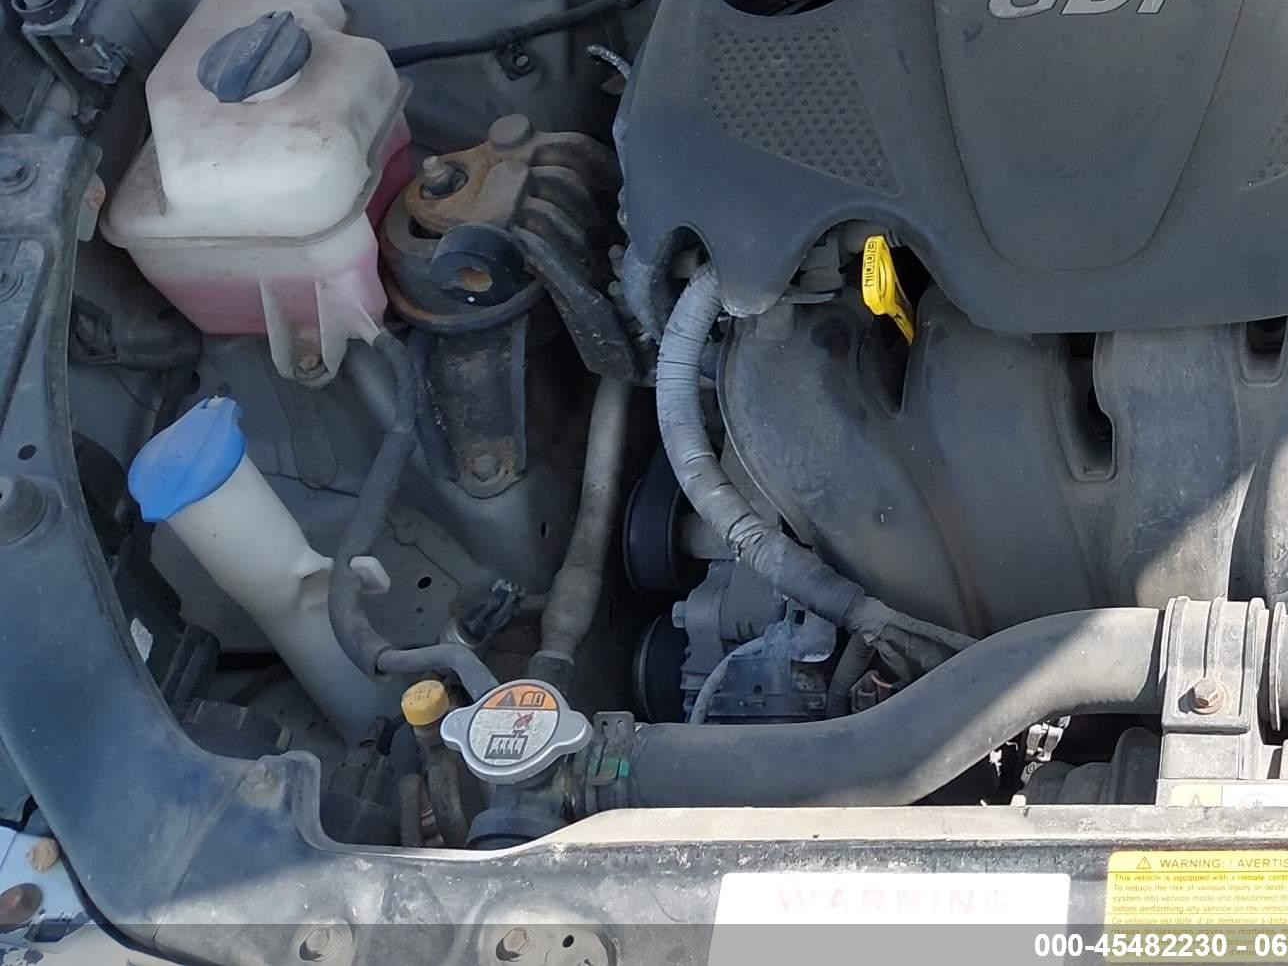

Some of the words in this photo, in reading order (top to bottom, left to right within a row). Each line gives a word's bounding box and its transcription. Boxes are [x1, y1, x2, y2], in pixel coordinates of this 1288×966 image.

[1160, 858, 1225, 868] WARNING:
[1173, 874, 1208, 883] equipped
[776, 888, 1009, 915] WARNING
[1113, 895, 1140, 903] system
